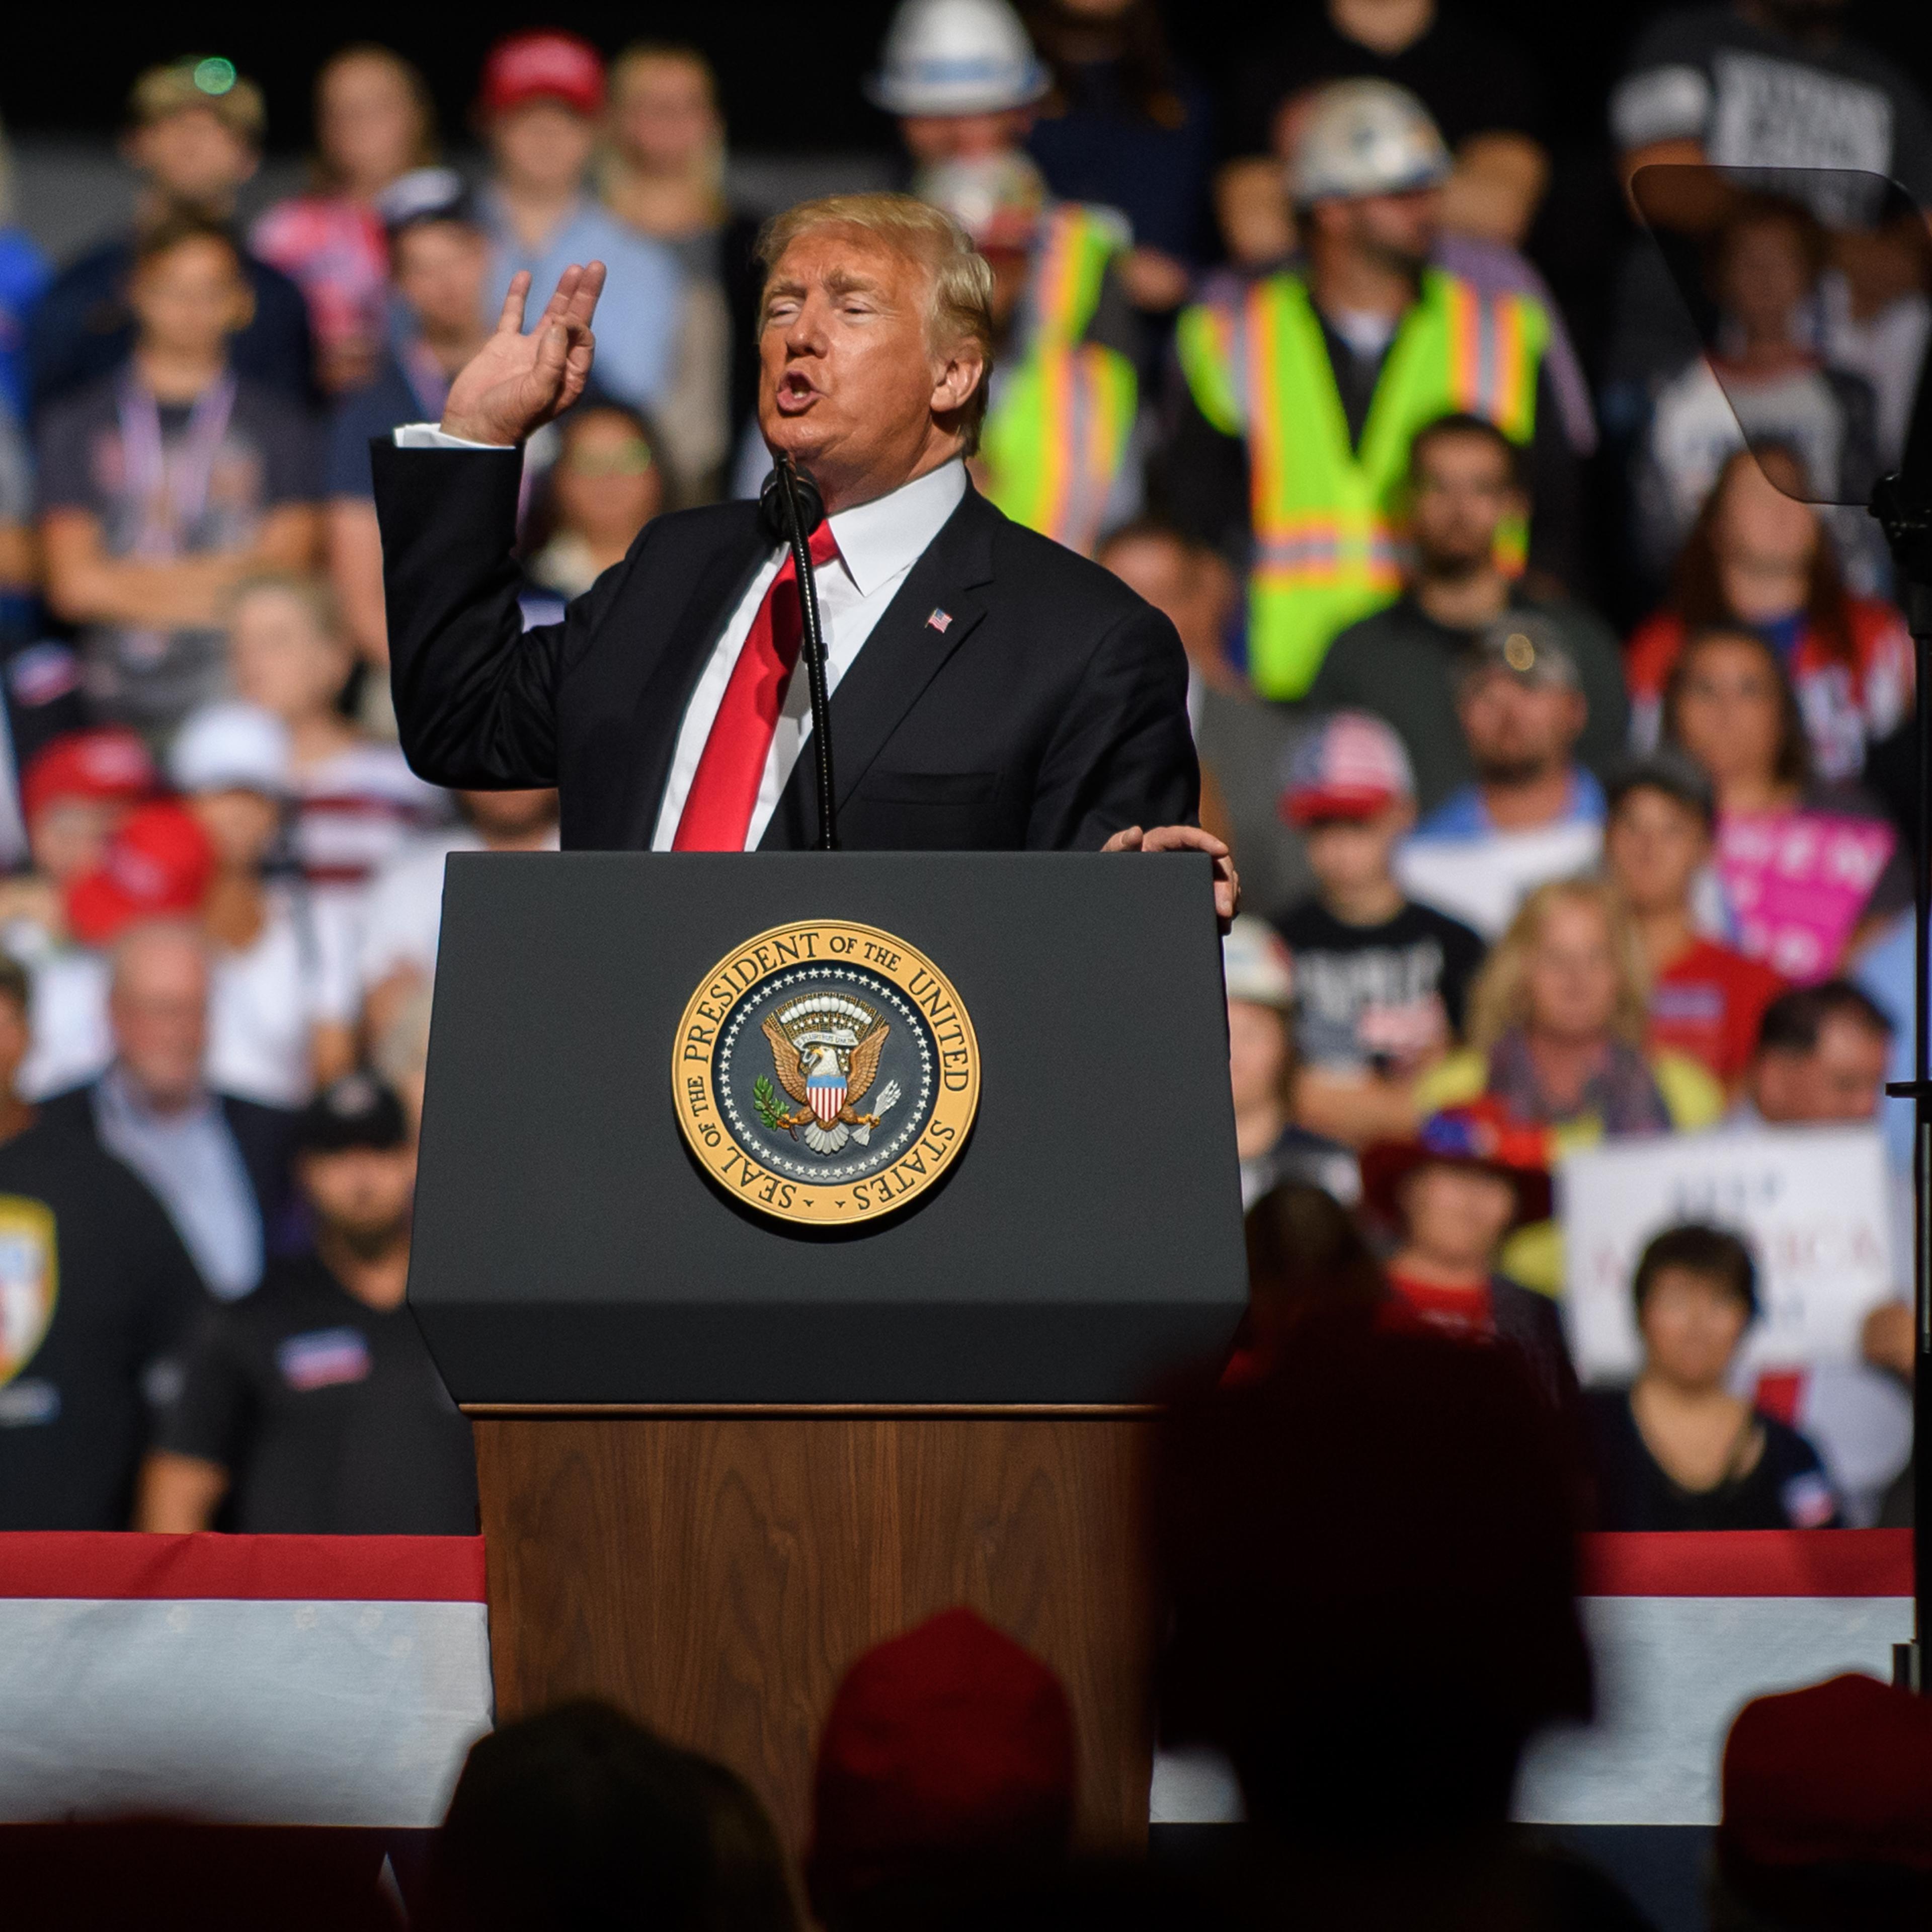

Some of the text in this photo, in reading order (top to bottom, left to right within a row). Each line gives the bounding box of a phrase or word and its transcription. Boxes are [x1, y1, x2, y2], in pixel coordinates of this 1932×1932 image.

[684, 932, 969, 1211] SEAL OF THE PRESIDENT OF THE UNITED STATES
